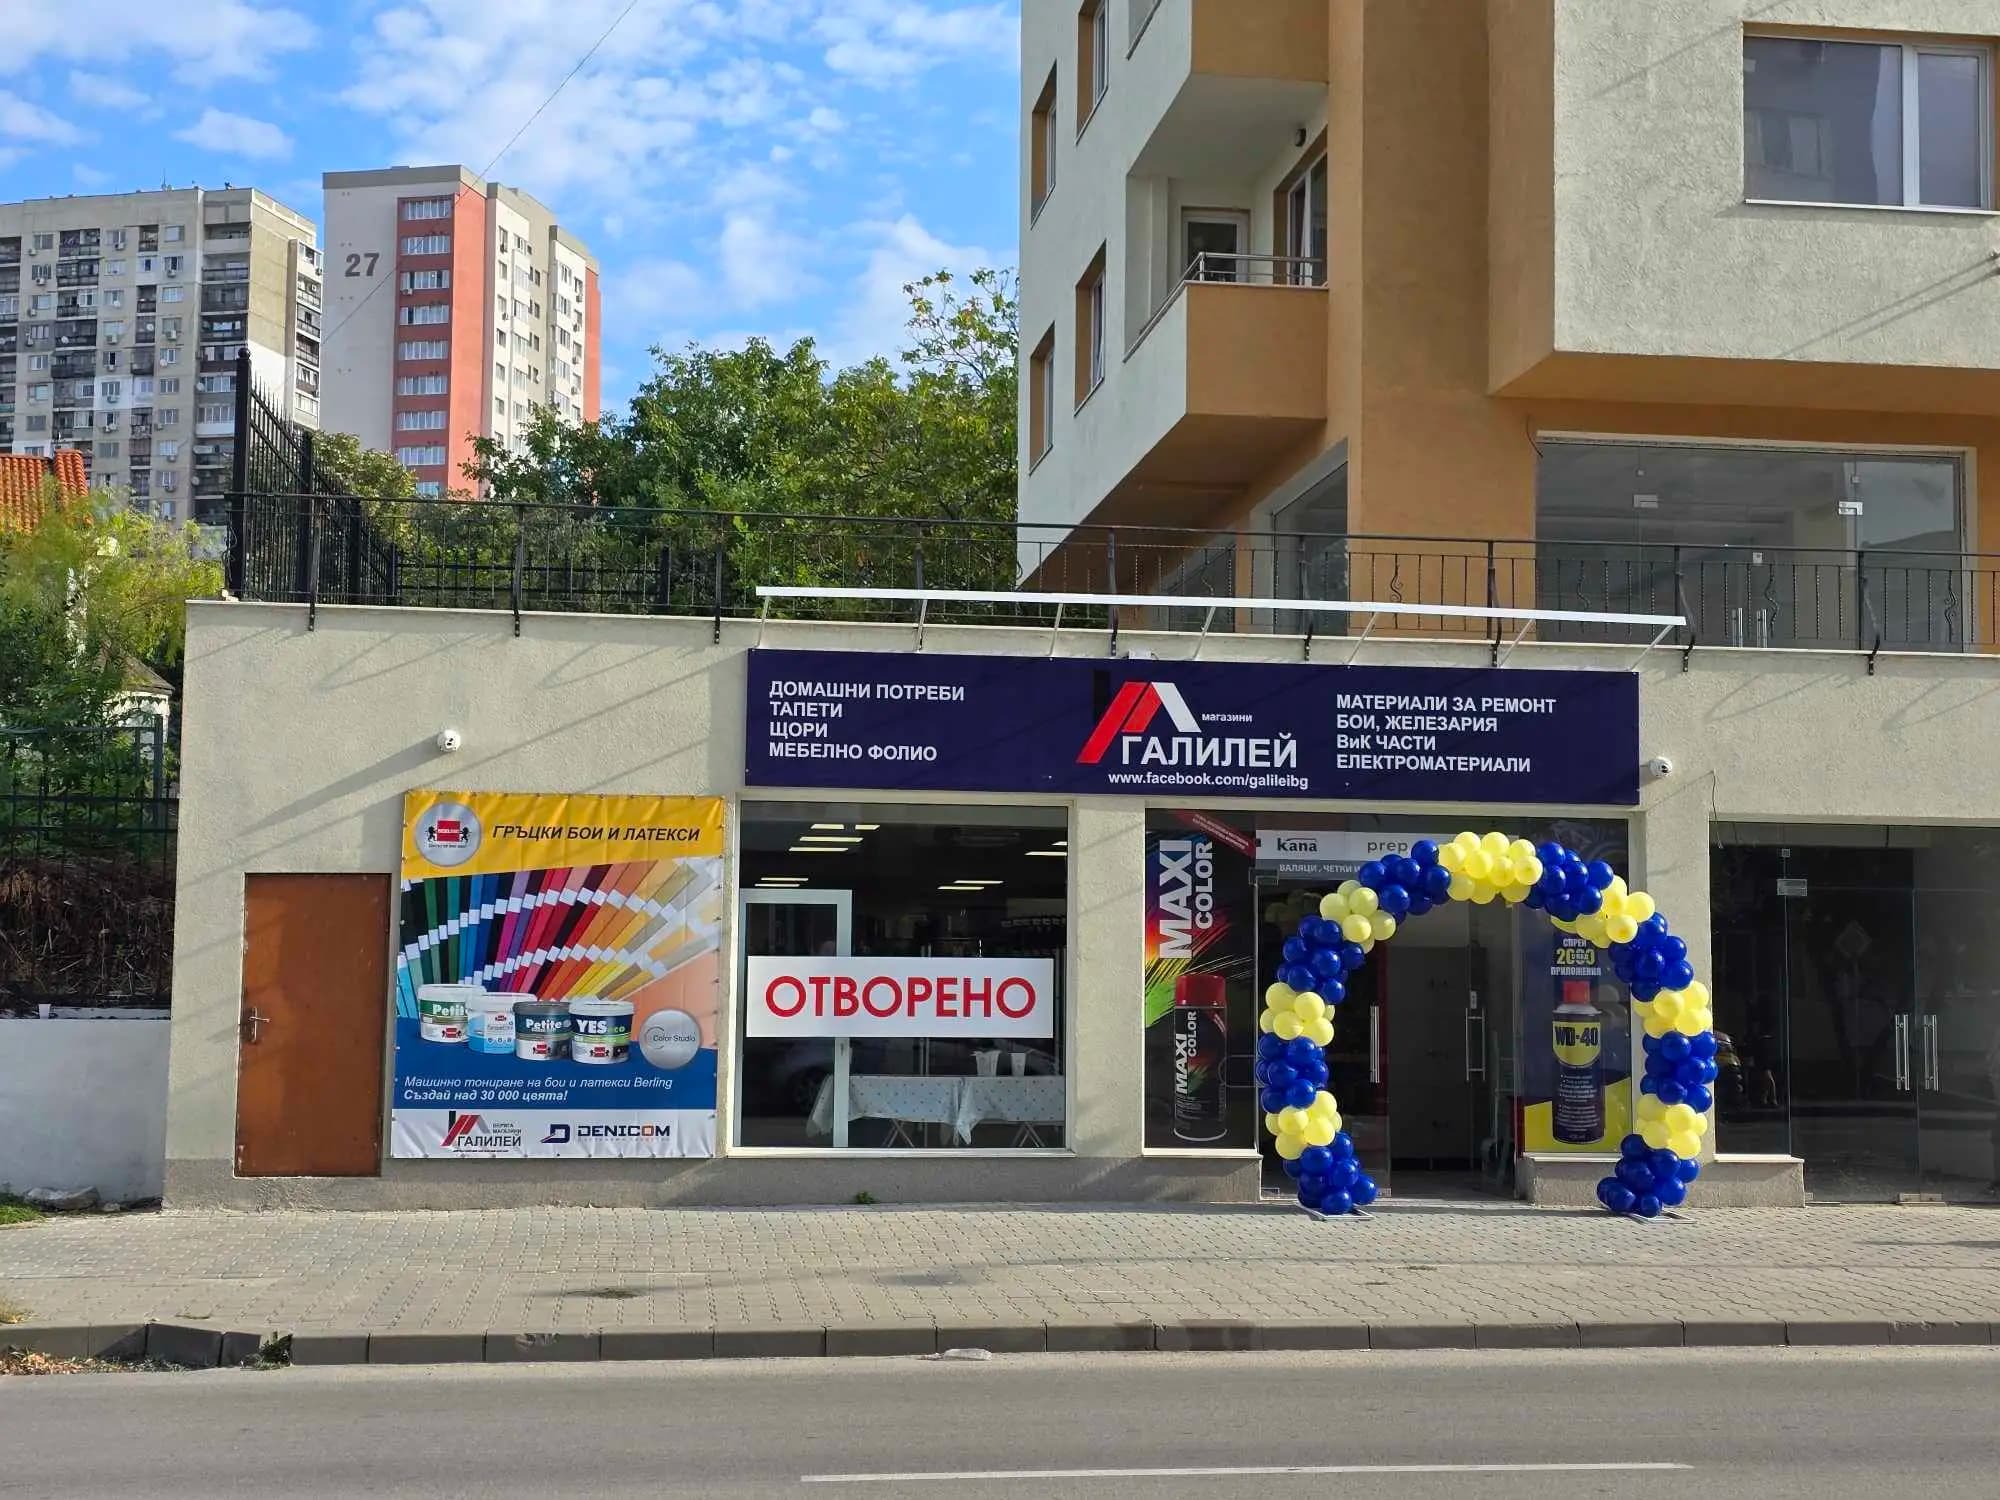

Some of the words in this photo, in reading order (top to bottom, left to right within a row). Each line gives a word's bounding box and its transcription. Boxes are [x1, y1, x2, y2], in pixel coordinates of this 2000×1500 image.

[345, 252, 380, 278] 27
[769, 680, 871, 699] ДОМАШНИ
[876, 683, 965, 701] ПОТРЕБИ
[769, 701, 843, 718] ТАПЕТИ
[1336, 694, 1448, 711] МАТЕРИАЛИ
[1452, 696, 1477, 712] ЗА
[1481, 697, 1557, 713] РЕМОНТ
[1201, 712, 1253, 723] магазини
[1336, 713, 1381, 732] БОИ,
[1385, 715, 1498, 732] ЖЕЛЕЗАРИЯ
[769, 721, 828, 739] ЩОРИ
[769, 742, 863, 760] МЕБЕЛНО
[867, 744, 938, 761] ФОЛИО
[1121, 731, 1297, 769] ГАЛИЛЕЙ
[1336, 733, 1371, 749] ВиК
[1376, 735, 1436, 751] ЧАСТИ
[1336, 753, 1531, 773] ЕЛЕКТРОМАТЕРИАЛИ
[1108, 771, 1310, 791] www.facebook.com/galileibg
[492, 825, 564, 841] ГРЪЦКИ
[567, 826, 604, 840] БОИ
[607, 827, 620, 841] И
[623, 827, 701, 841] ЛАТЕКСИ
[1277, 838, 1318, 852] kana
[1323, 864, 1352, 873] ЧЕТКИ
[1195, 840, 1214, 930] COLOR
[1159, 839, 1193, 959] MAXI
[765, 975, 1037, 1019] ОТВОРЕНО
[432, 1003, 465, 1016] Petit
[525, 1018, 562, 1029] Petite
[576, 1019, 608, 1034] YES
[1187, 1010, 1197, 1057] COLOR
[1554, 1025, 1599, 1047] WD-40
[1175, 1033, 1188, 1095] MAXI
[404, 1075, 462, 1087] Машинно
[464, 1079, 524, 1089] тониране
[527, 1079, 541, 1088] на
[544, 1076, 566, 1088] бои
[569, 1079, 577, 1088] и
[580, 1079, 631, 1088] латекси
[633, 1076, 673, 1090] Berling
[403, 1089, 451, 1101] Създай
[454, 1089, 478, 1101] над
[480, 1089, 495, 1101] 30
[497, 1089, 520, 1101] 000
[522, 1090, 569, 1102] цвята!
[577, 1124, 671, 1137] DENICOM
